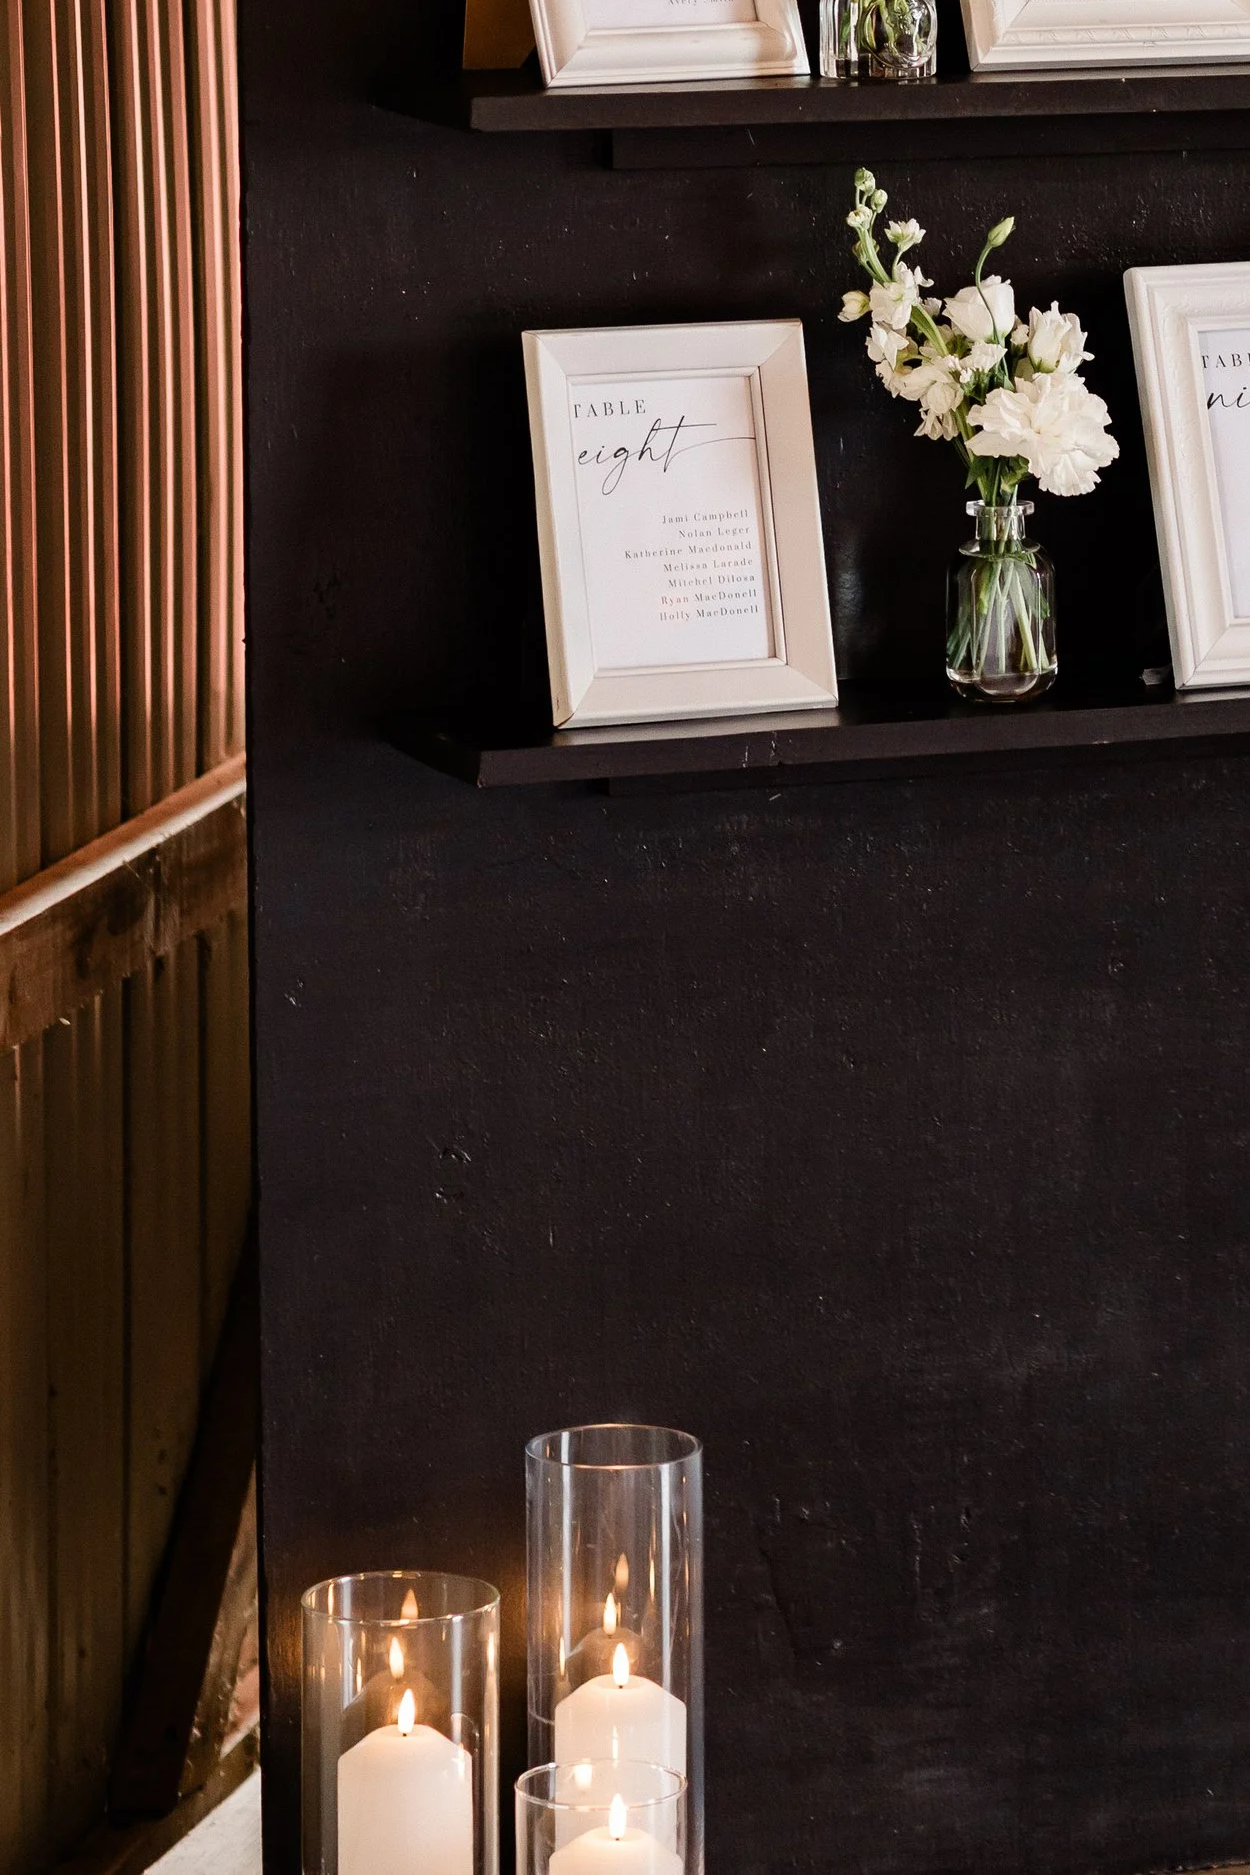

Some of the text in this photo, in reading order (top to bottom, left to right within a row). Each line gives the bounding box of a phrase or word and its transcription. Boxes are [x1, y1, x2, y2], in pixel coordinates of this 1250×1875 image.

[578, 416, 756, 495] eight
[662, 509, 748, 524] Jami Campbell
[679, 527, 750, 538] Nolan Leger
[625, 549, 682, 559] Katherine
[664, 563, 708, 572] Melissa
[661, 596, 689, 606] Ryan
[660, 611, 690, 621] Holly
